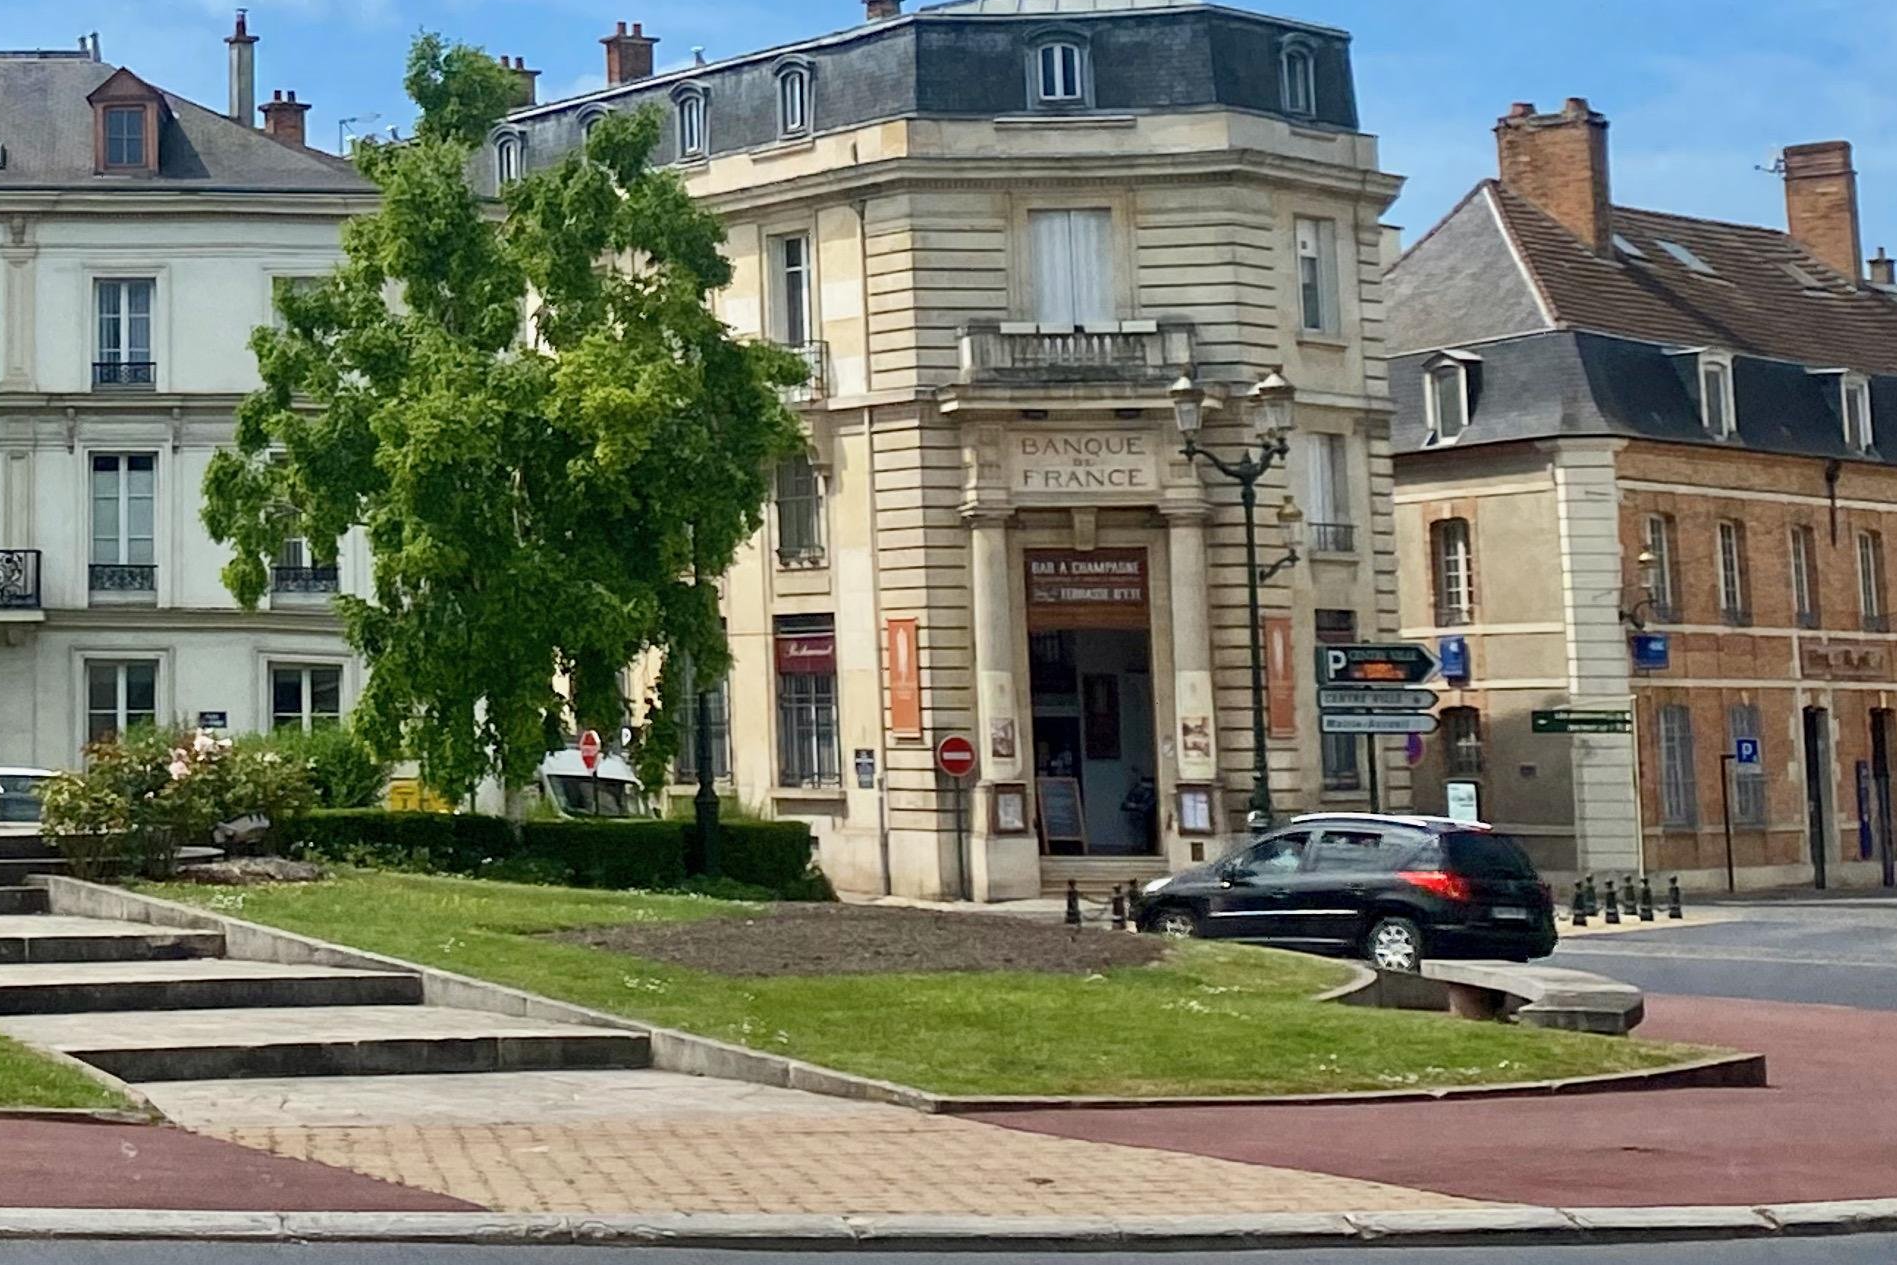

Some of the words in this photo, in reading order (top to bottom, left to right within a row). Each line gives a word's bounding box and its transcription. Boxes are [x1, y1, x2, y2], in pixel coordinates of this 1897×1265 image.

[1021, 437, 1146, 457] BANQUE
[1023, 469, 1147, 487] FRANCE
[1031, 561, 1055, 574] BAR
[1071, 561, 1140, 574] CHAMPAGNE
[1327, 650, 1347, 679] P
[1741, 742, 1753, 761] P
